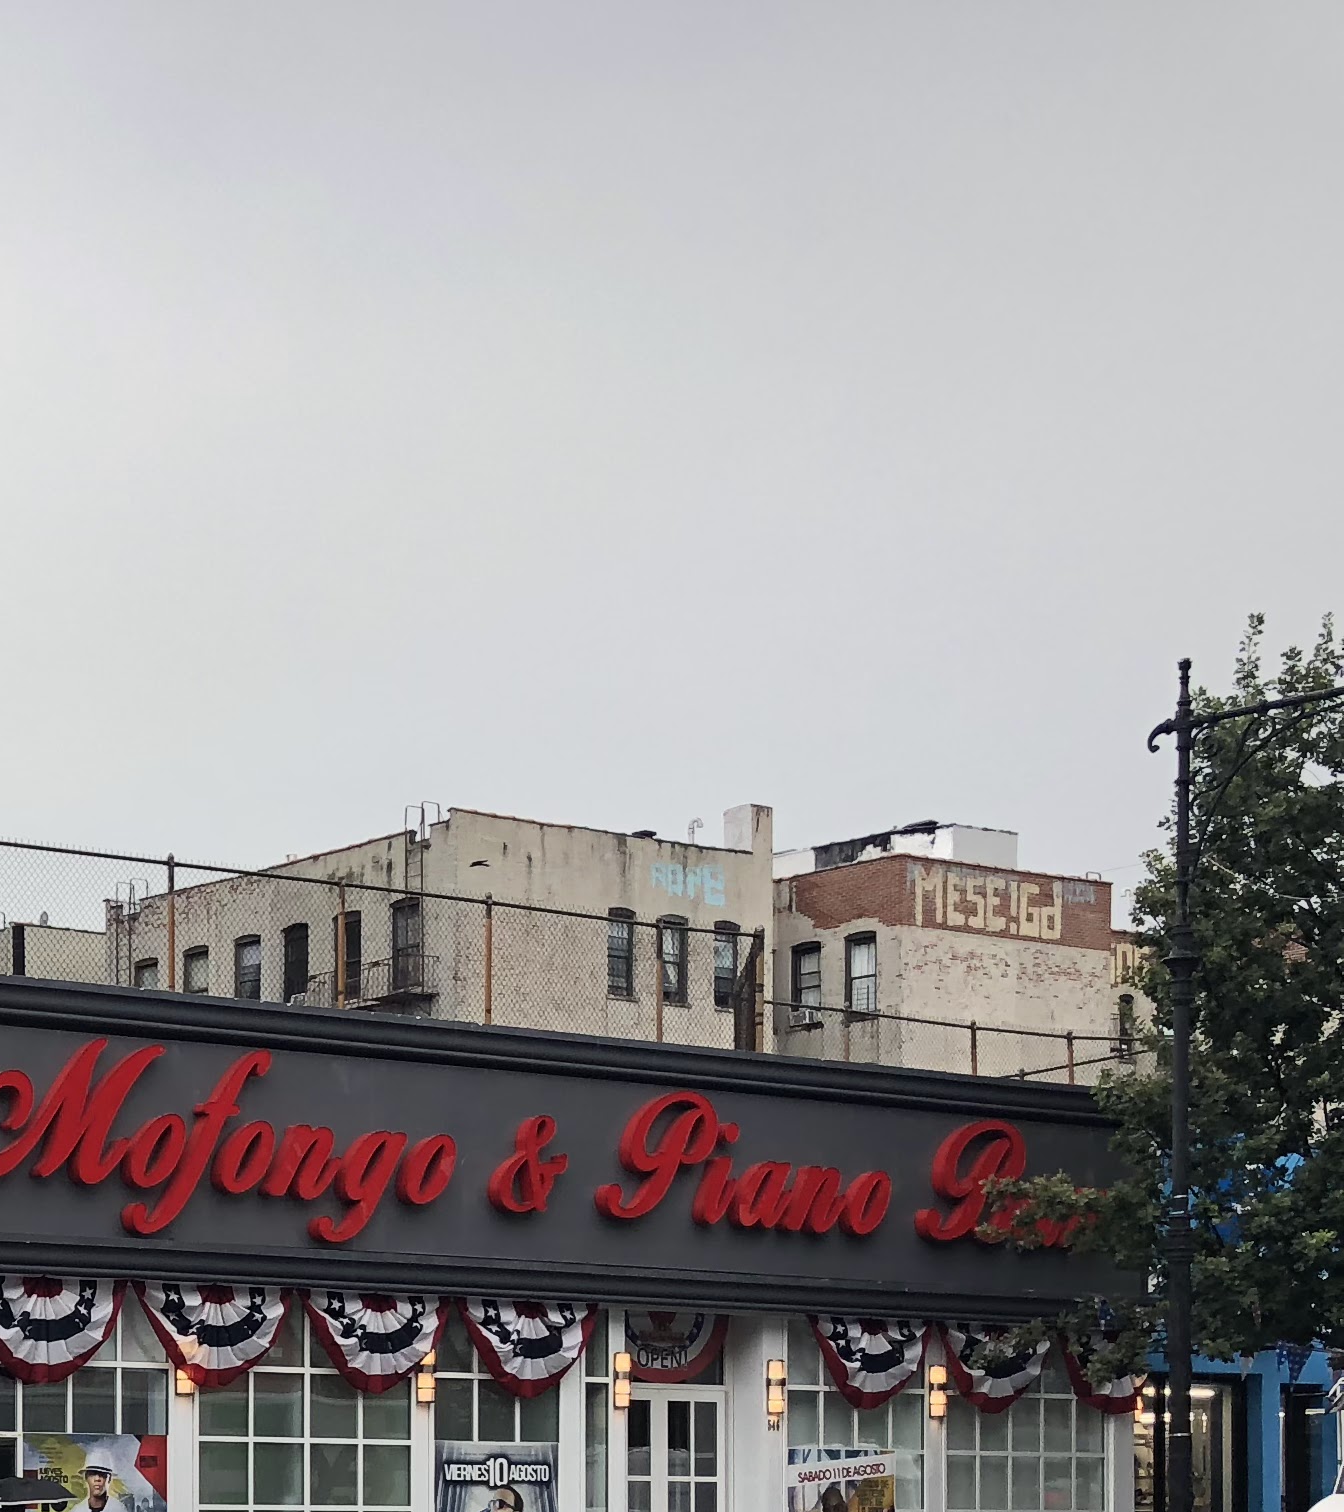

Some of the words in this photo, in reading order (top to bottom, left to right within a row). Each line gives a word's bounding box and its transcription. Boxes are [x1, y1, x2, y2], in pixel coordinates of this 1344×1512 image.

[487, 1114, 569, 1214] &
[594, 1089, 893, 1238] Piano
[444, 1463, 489, 1482] VIERNES
[489, 1457, 509, 1487] 10
[509, 1464, 550, 1482] AGOSTO
[797, 1469, 832, 1483] SABADO
[842, 1466, 852, 1478] DE
[852, 1463, 886, 1477] AGOSTO
